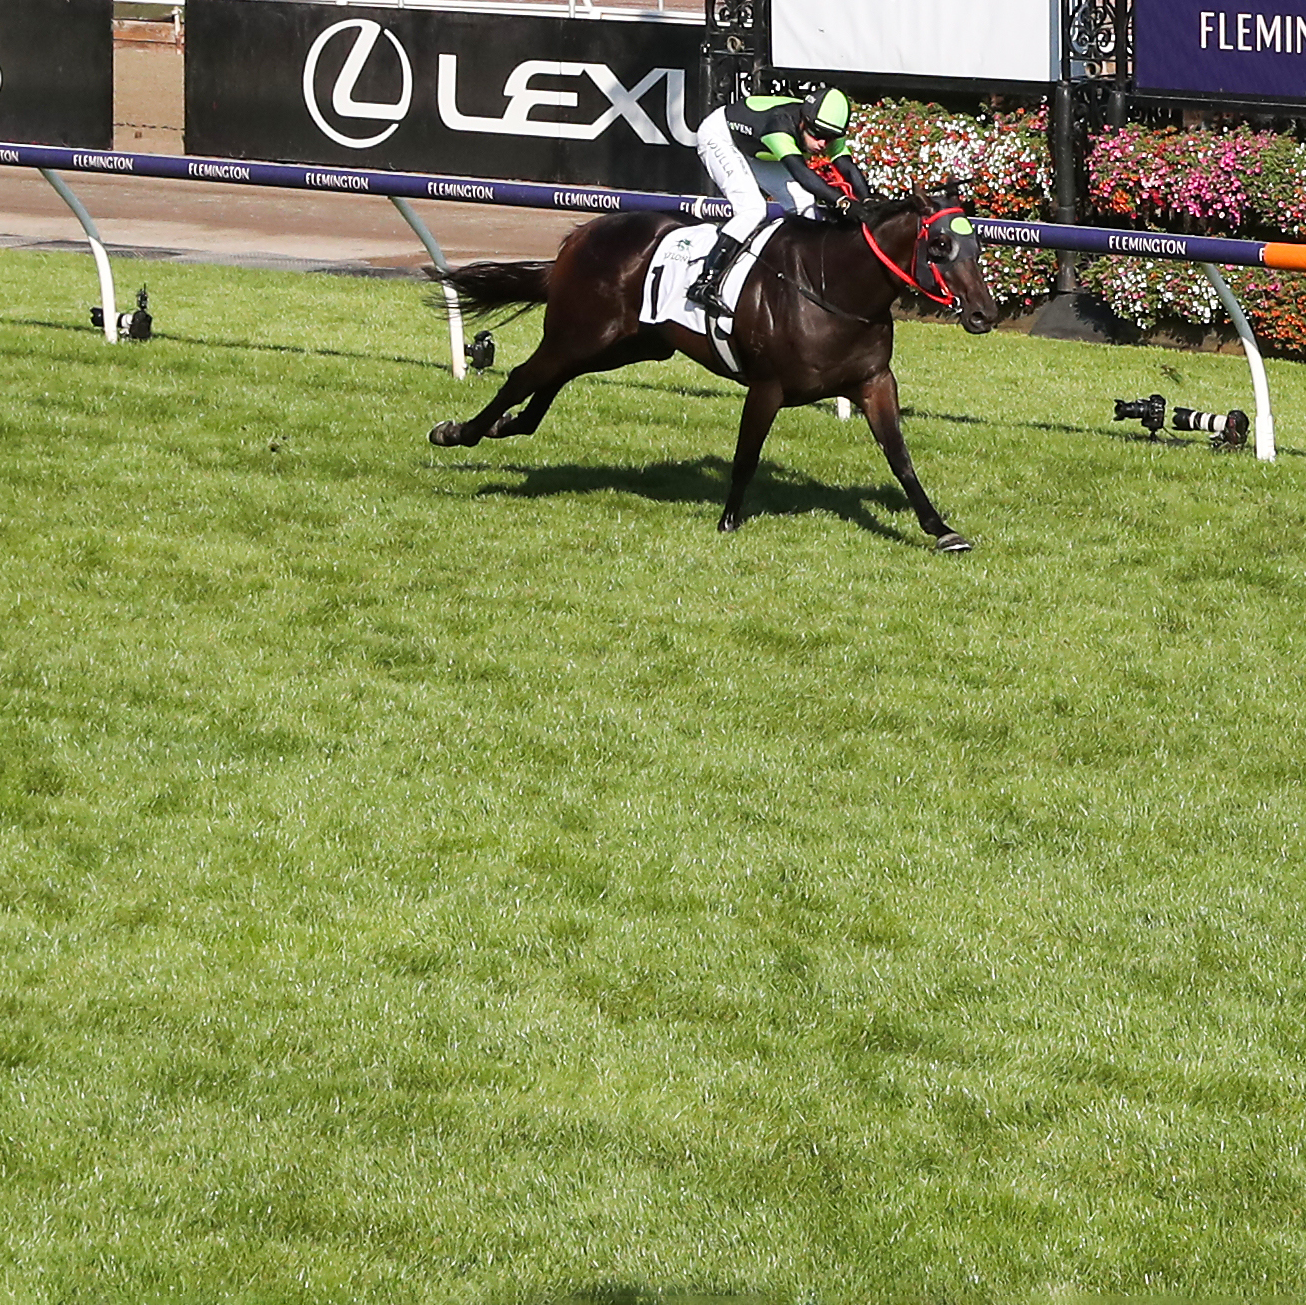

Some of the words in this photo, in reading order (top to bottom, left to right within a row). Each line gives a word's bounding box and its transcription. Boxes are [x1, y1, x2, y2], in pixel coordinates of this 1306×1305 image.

[437, 53, 698, 147] LEXU
[72, 153, 134, 172] FLEMINGTON
[187, 162, 250, 181] FLEMINGTON
[304, 171, 369, 191] FLEMINGTON
[427, 180, 494, 201] FLEMINGTON
[553, 190, 621, 210] FLEMINGTON
[1107, 234, 1187, 256] FLEMINGTON
